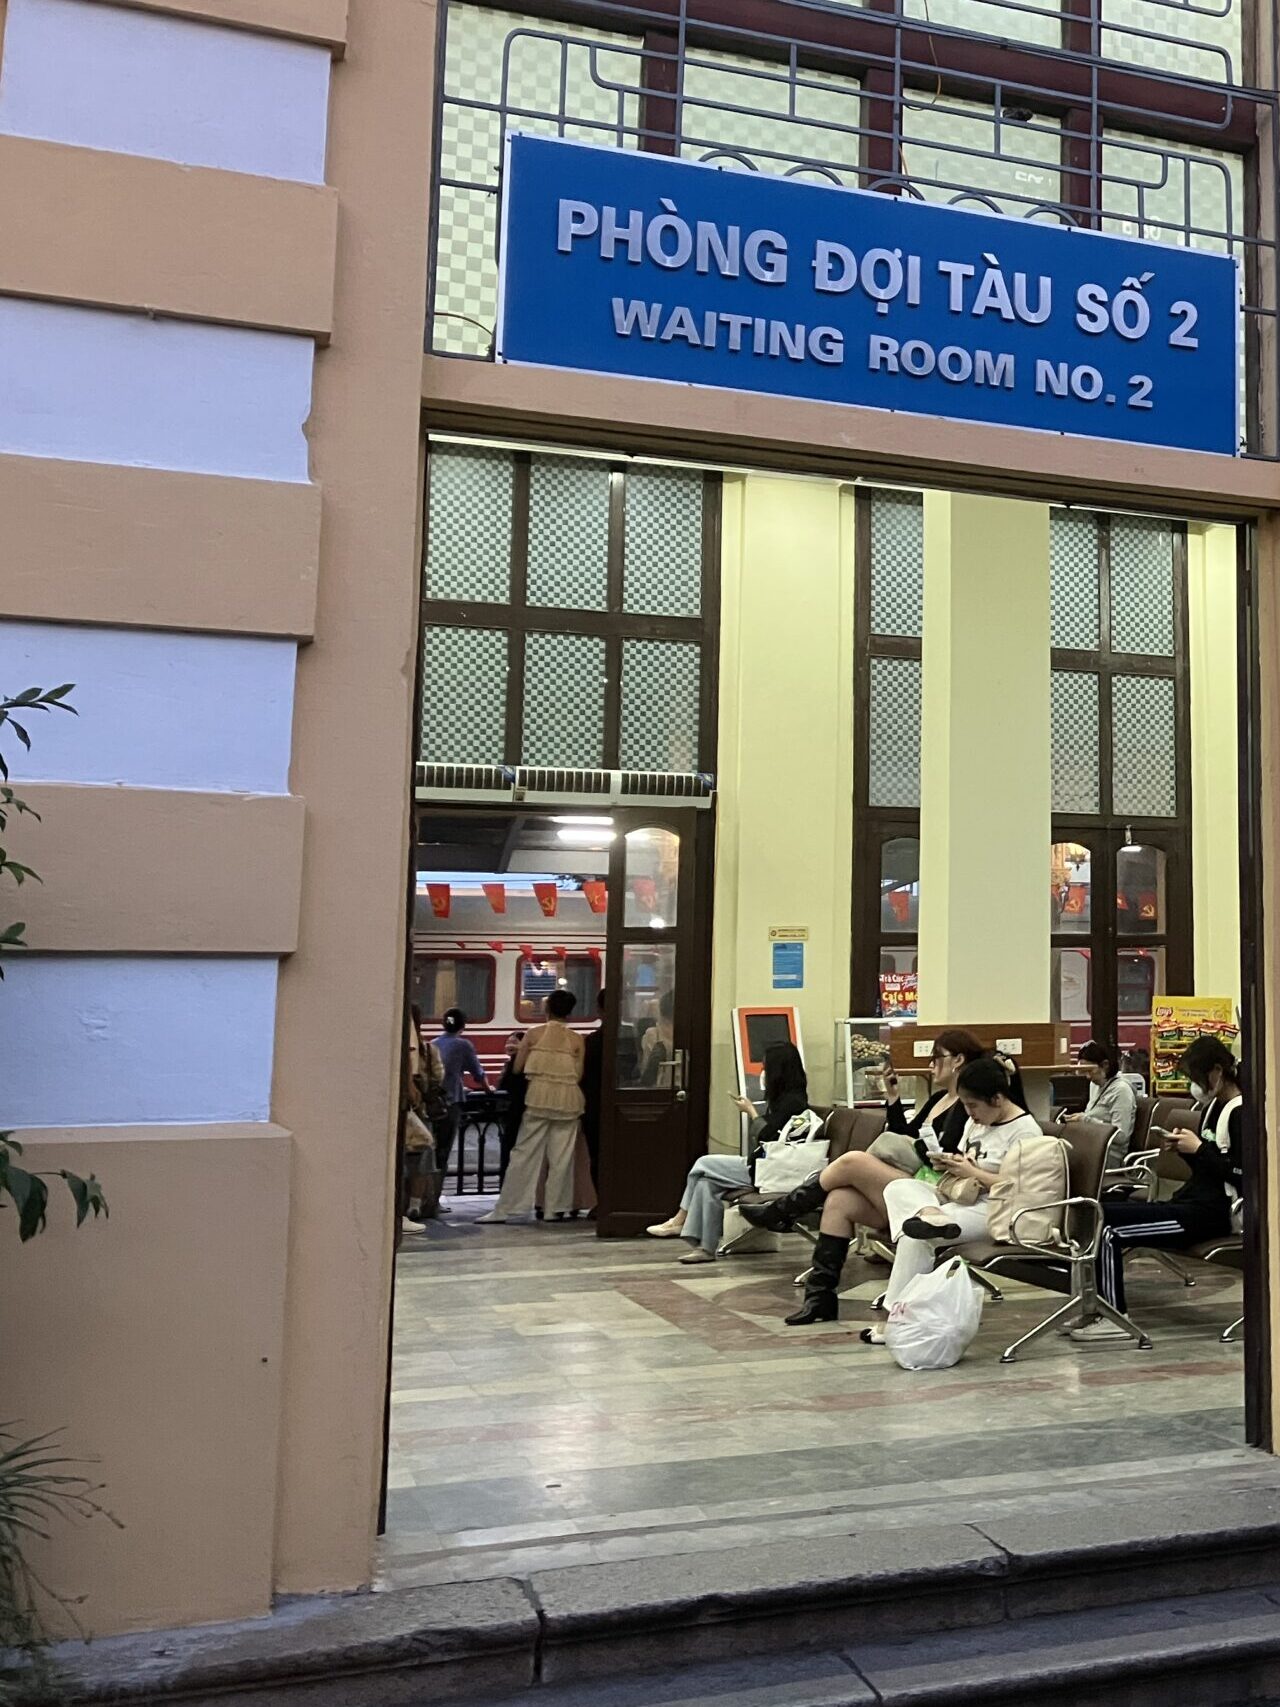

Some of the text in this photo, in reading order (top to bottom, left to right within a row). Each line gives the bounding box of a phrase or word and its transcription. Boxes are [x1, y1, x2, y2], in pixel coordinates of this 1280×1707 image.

[557, 197, 1199, 348] PHÒNG ĐỢI TÀU SỐ 2
[611, 297, 1153, 408] WAITING ROOM NO. 2
